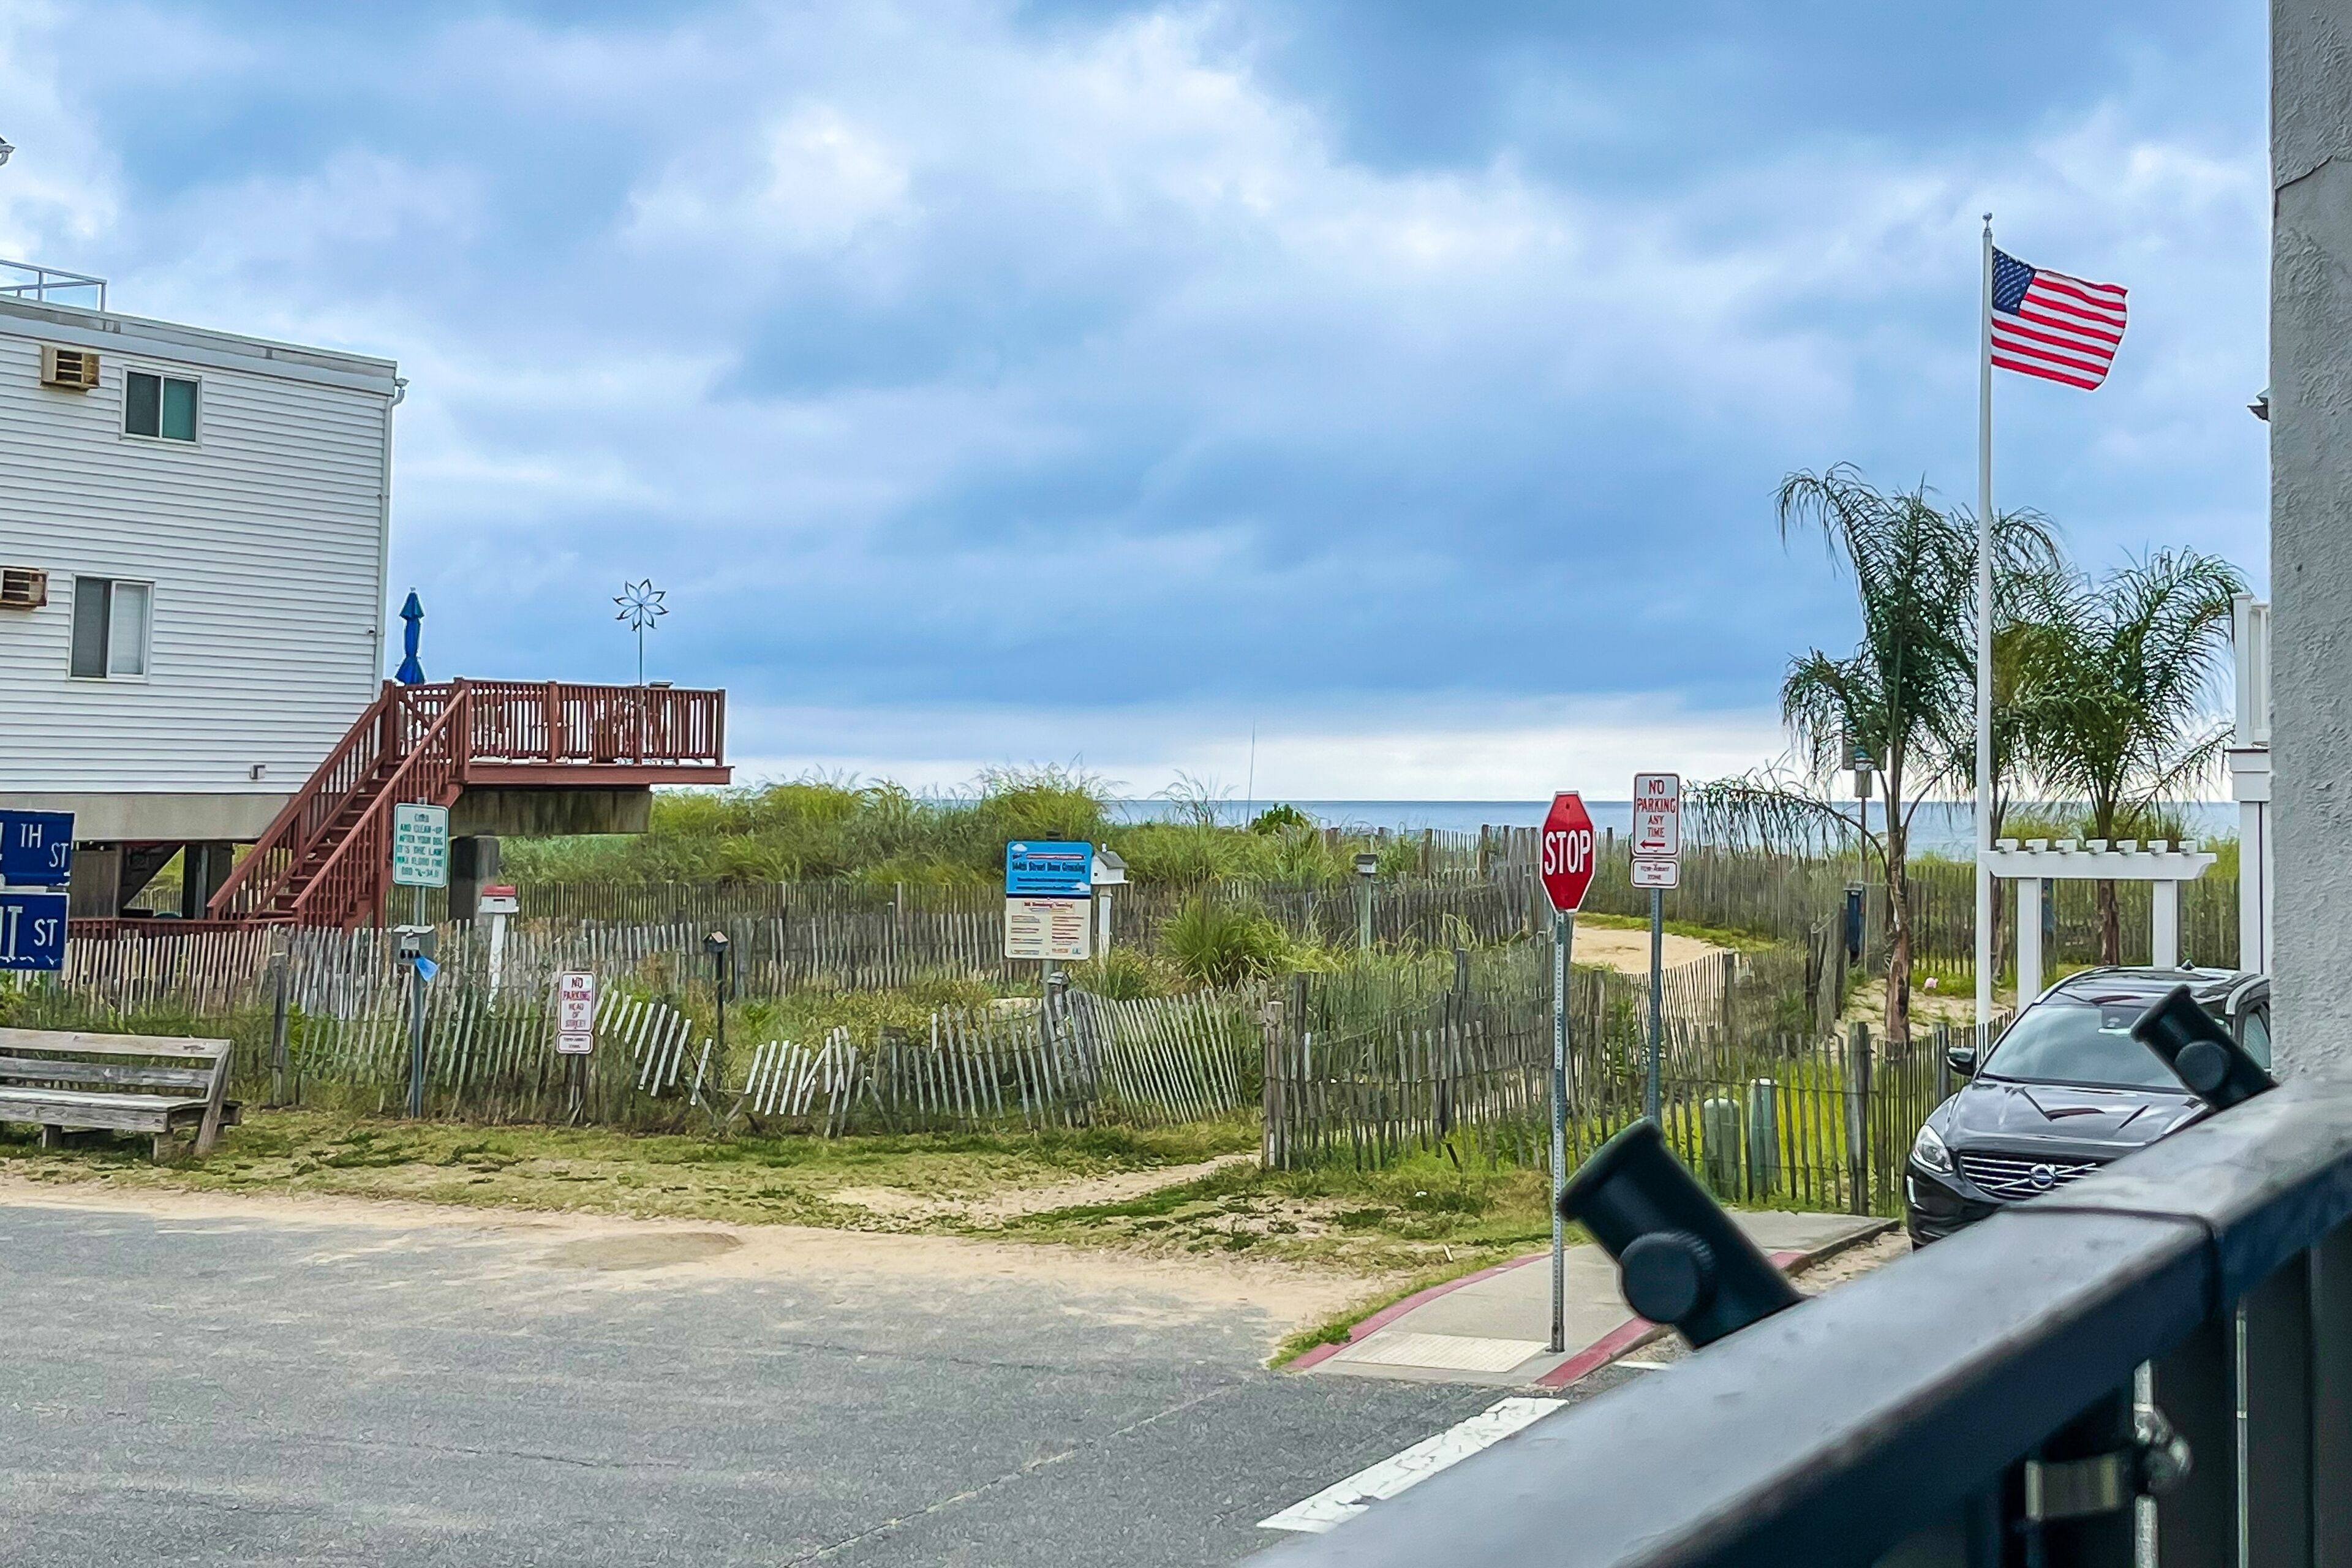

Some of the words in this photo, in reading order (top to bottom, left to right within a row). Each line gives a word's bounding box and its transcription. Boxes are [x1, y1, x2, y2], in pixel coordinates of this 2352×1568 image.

[1648, 779, 1665, 794] NO
[1636, 797, 1676, 813] PARKING
[1647, 827, 1665, 838] TIME
[48, 842, 69, 868] ST
[1544, 829, 1591, 875] STOP
[34, 919, 58, 946] ST
[571, 977, 583, 988] NO
[563, 990, 591, 1001] PARKING
